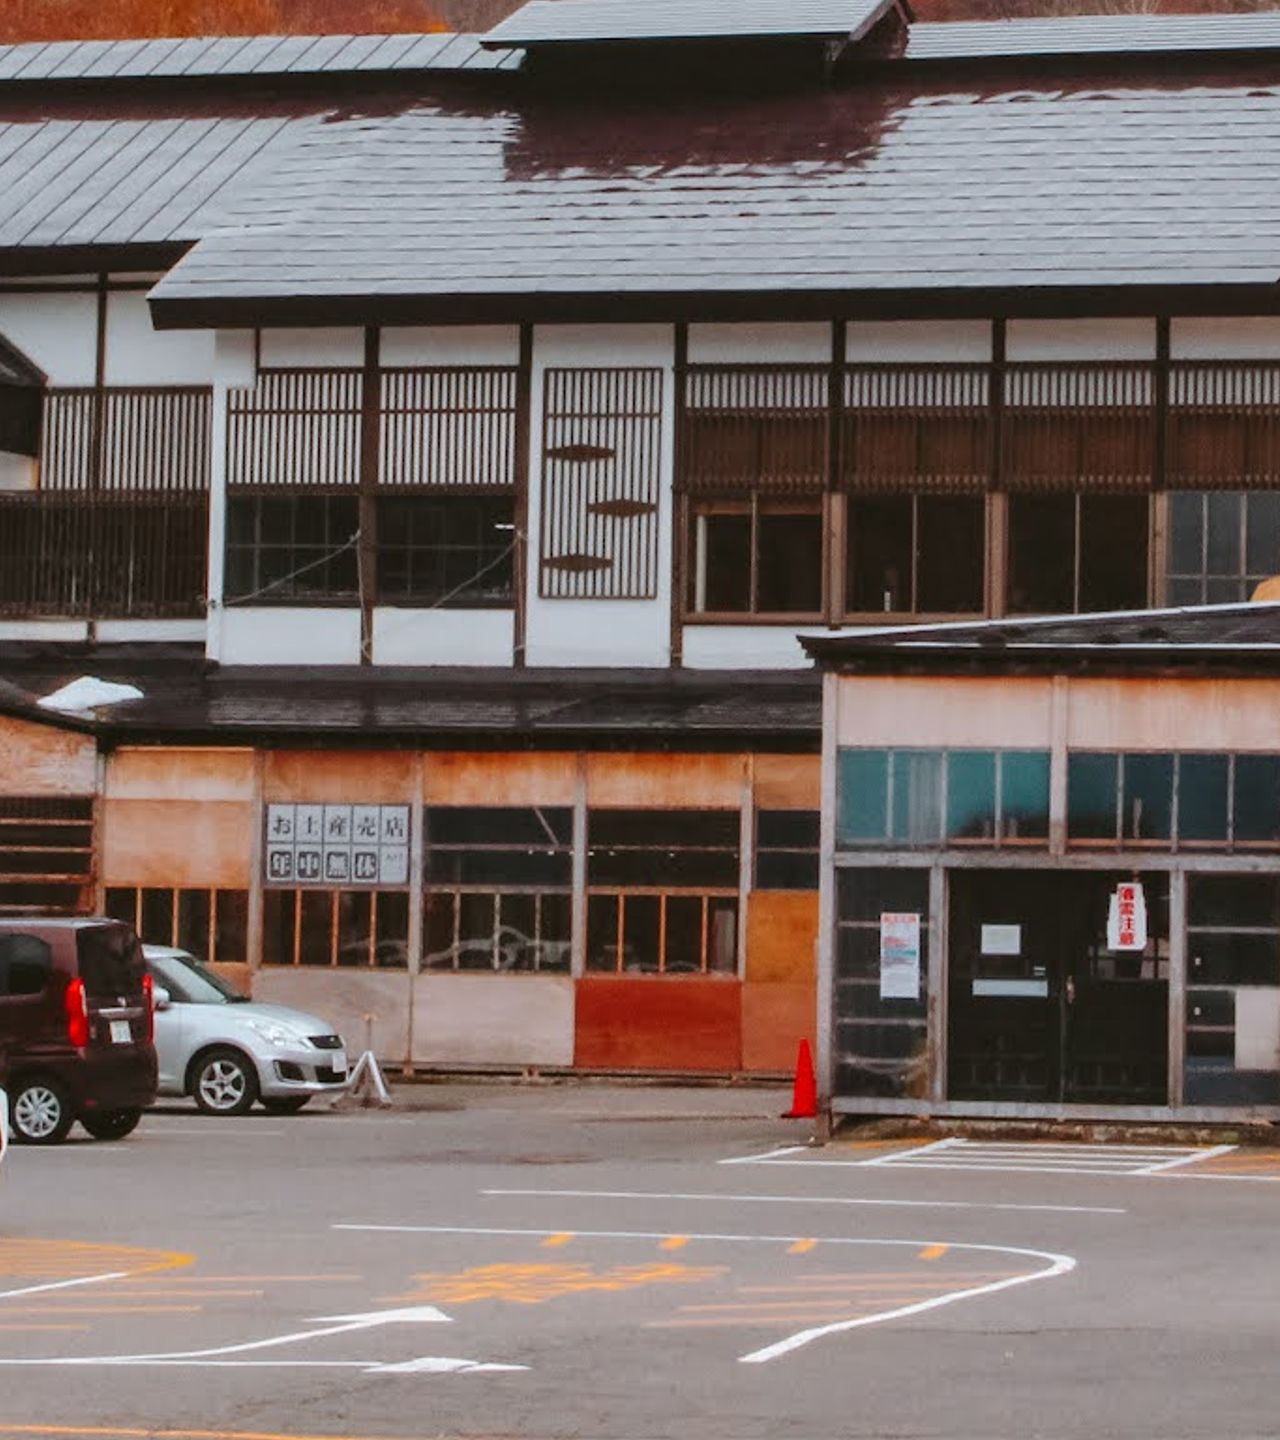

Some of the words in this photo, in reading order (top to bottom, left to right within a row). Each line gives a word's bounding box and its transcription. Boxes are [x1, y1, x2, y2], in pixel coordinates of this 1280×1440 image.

[272, 814, 404, 838] お土産売店
[270, 850, 376, 879] 年中無休
